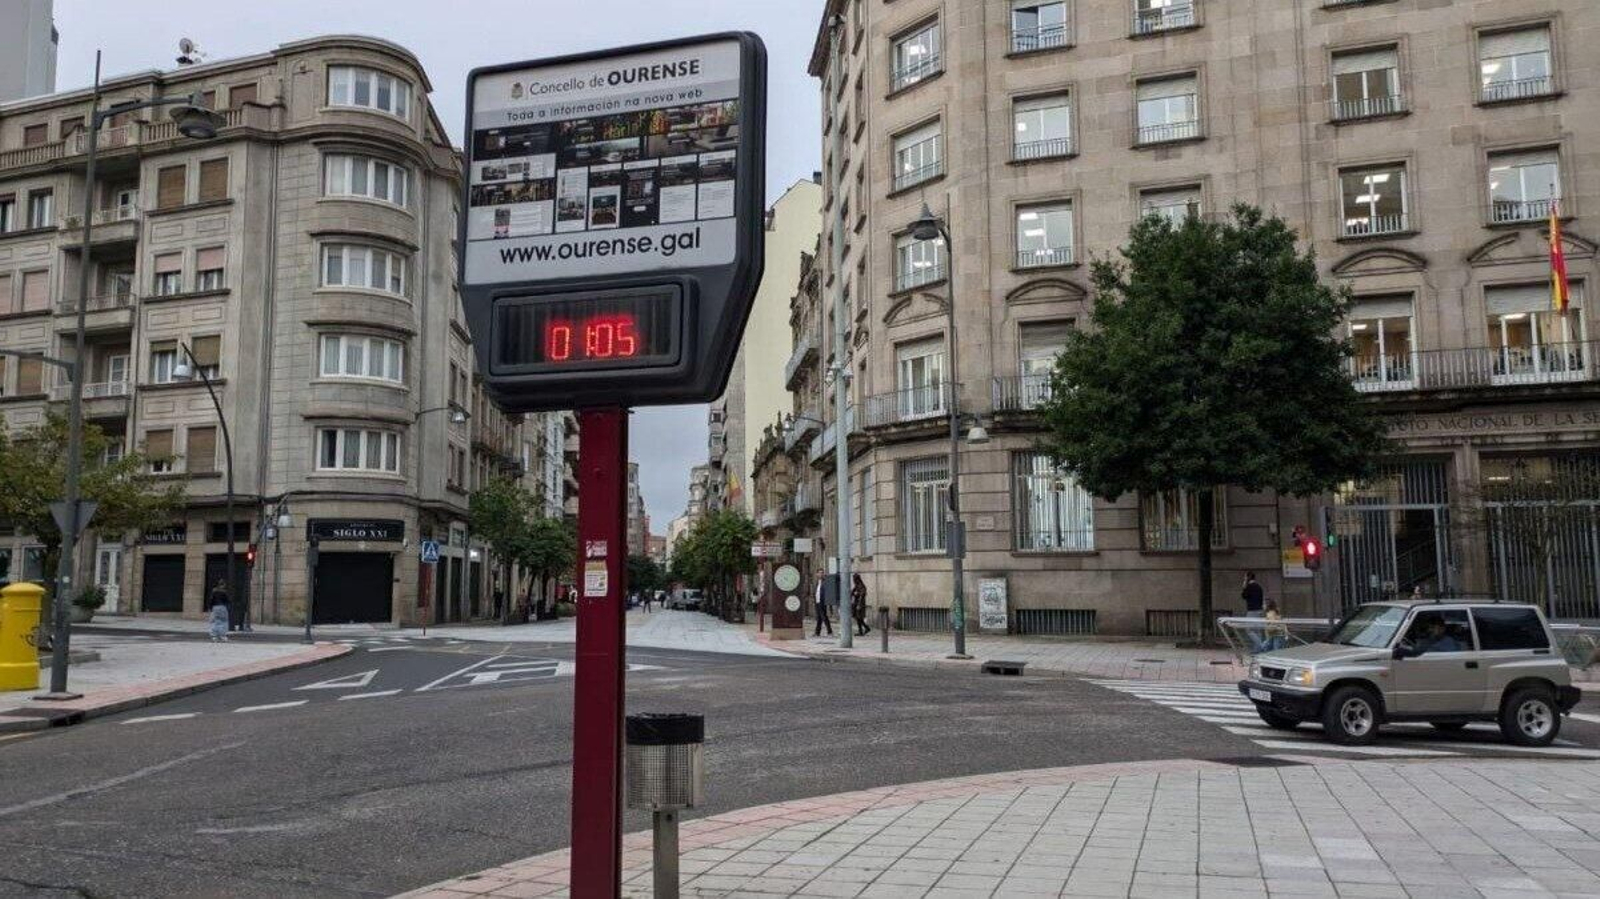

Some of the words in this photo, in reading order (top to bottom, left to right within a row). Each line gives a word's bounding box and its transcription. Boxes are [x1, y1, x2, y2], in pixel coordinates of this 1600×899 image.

[529, 78, 586, 96] Concello
[589, 76, 605, 88] de
[607, 59, 700, 87] OURENSE
[507, 110, 534, 122] Toda
[538, 109, 546, 118] a
[625, 96, 640, 107] na
[645, 92, 674, 105] nova
[679, 88, 703, 100] web
[500, 227, 701, 264] www.ourense.gal
[1438, 414, 1518, 431] NACIONAL
[1523, 414, 1544, 426] DE
[1554, 412, 1575, 425] LA
[333, 529, 366, 537] SIGLO
[370, 530, 388, 538] XXI
